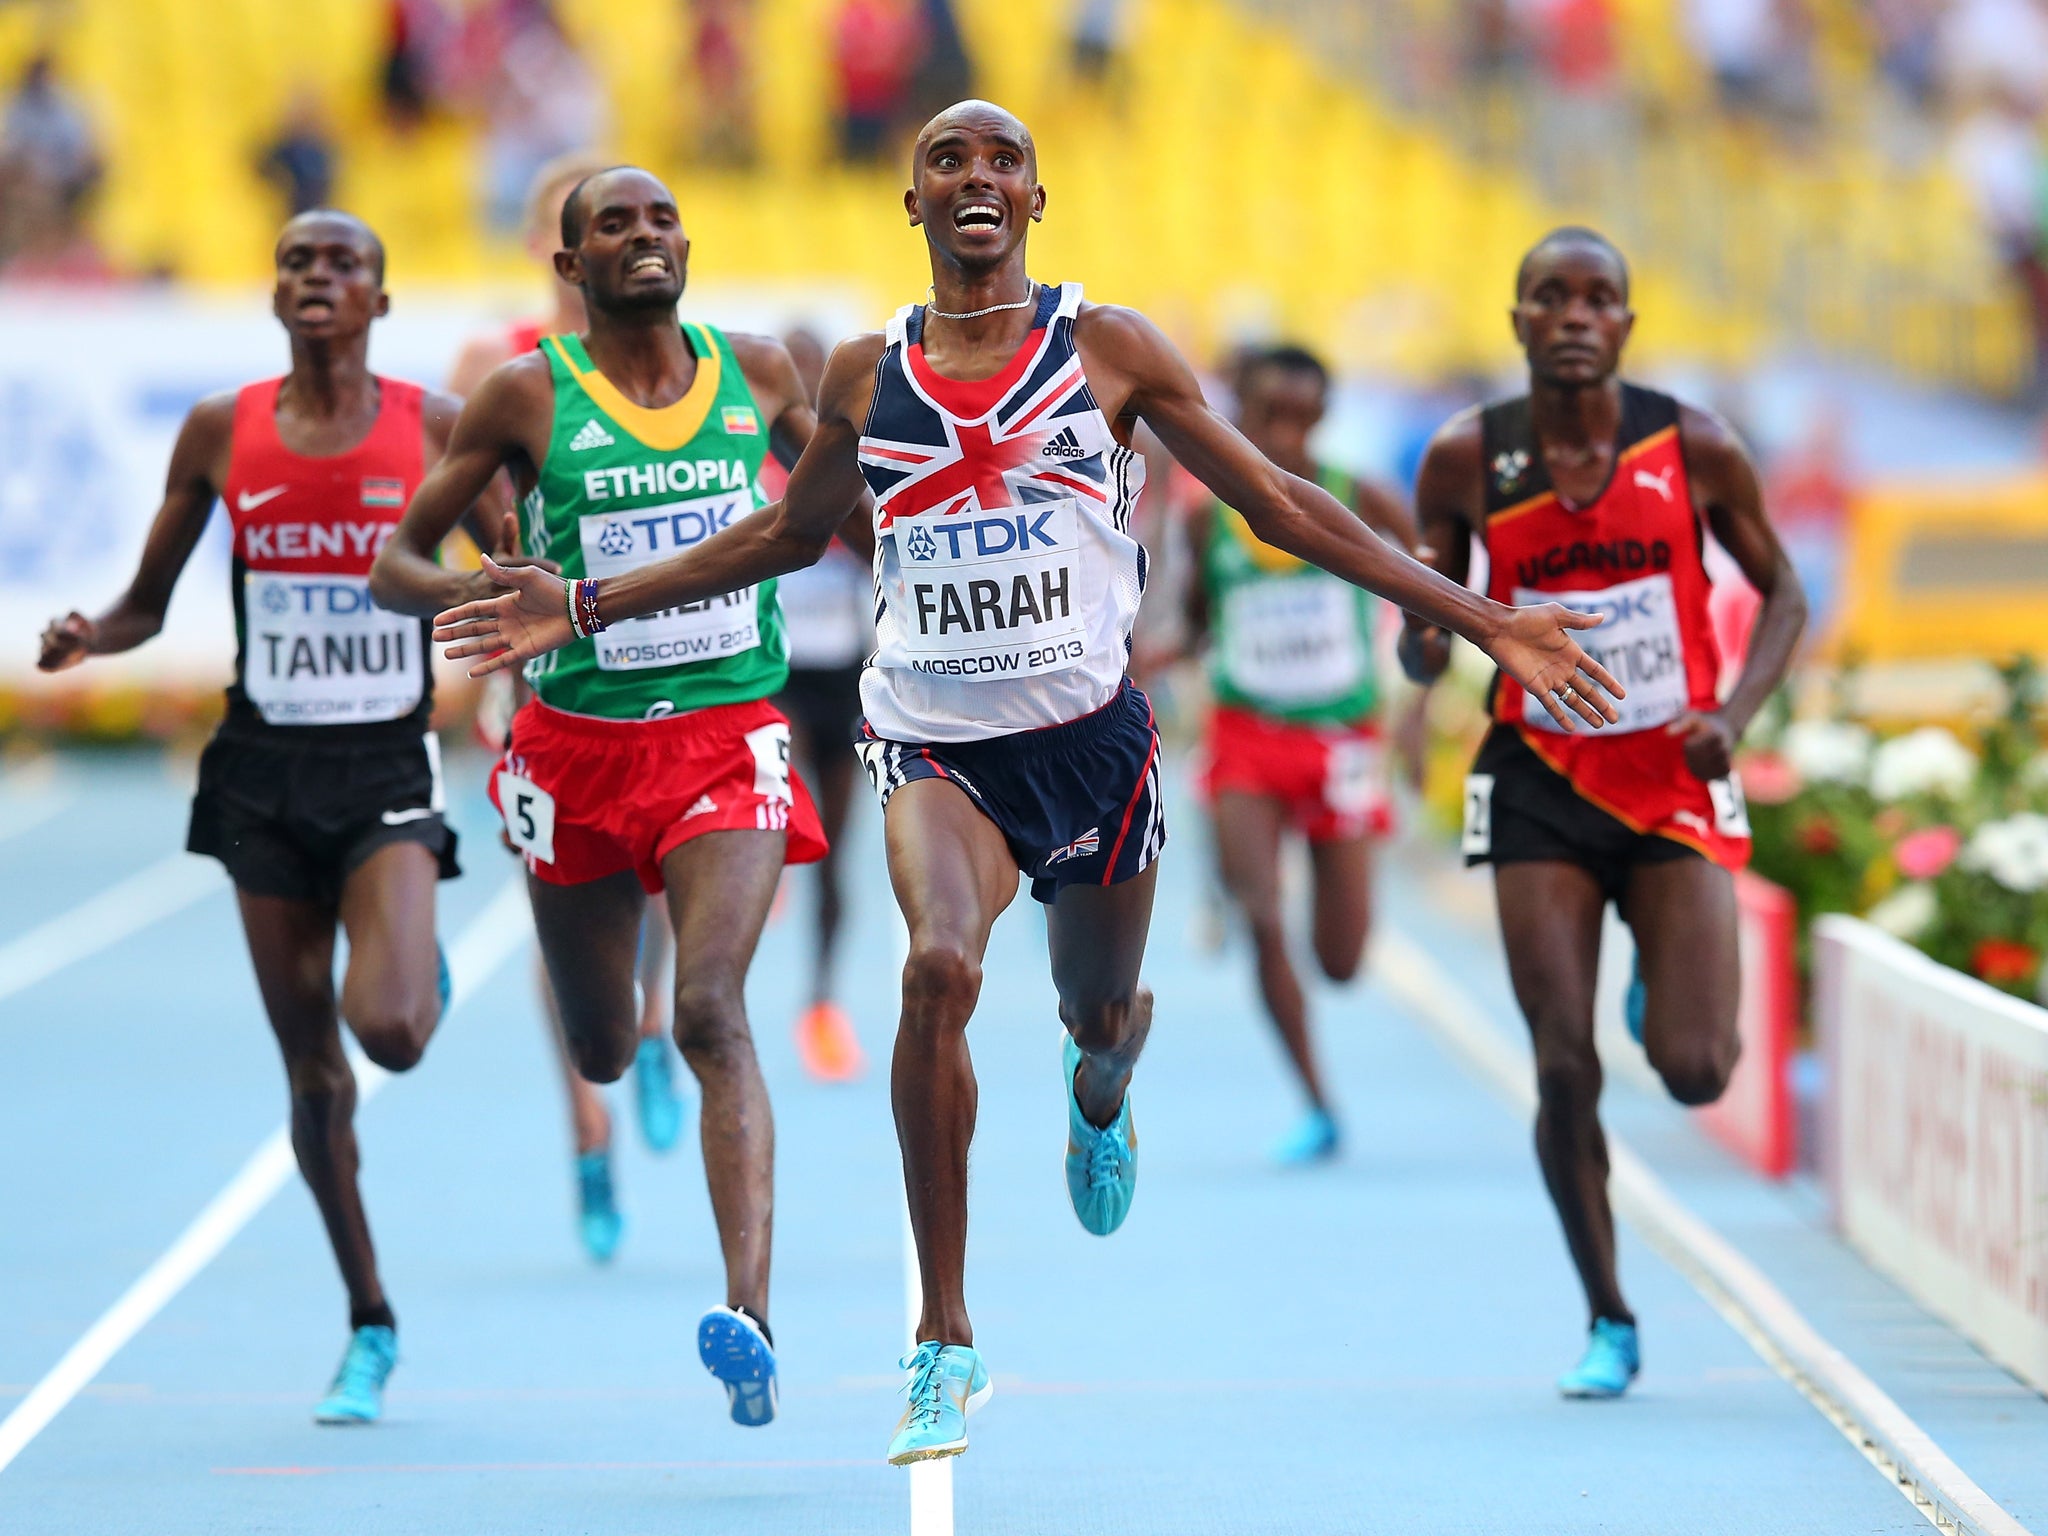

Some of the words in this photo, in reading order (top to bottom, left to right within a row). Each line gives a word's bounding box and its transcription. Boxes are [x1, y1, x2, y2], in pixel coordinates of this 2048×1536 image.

[1042, 438, 1085, 458] adidas
[584, 459, 749, 501] ETHIOPIA
[933, 510, 1059, 560] TDK
[1516, 540, 1673, 588] UGANDA
[913, 567, 1070, 635] FARAH
[262, 631, 406, 679] TANUI
[603, 635, 711, 665] MOSCOW
[911, 652, 1020, 676] MOSCOW
[1027, 640, 1084, 668] 2013
[516, 793, 536, 841] 5
